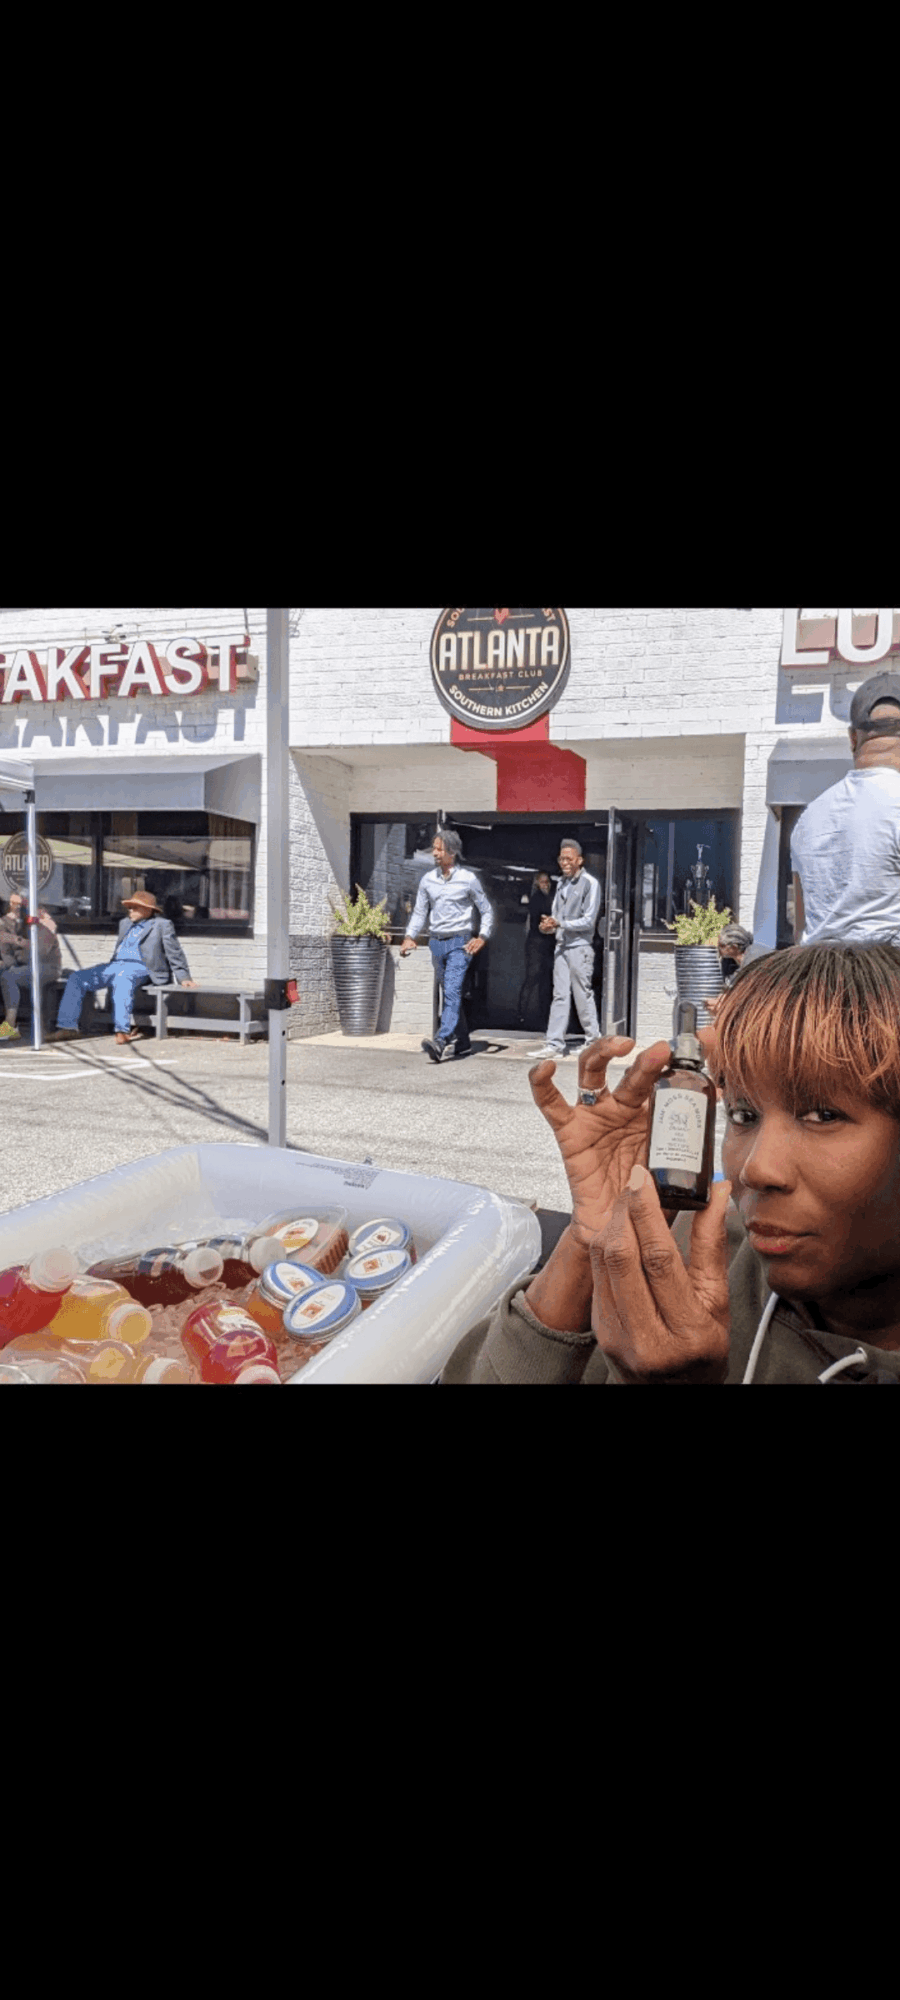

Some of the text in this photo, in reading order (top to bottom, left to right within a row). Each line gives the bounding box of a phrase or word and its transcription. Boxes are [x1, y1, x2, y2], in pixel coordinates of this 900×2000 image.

[439, 625, 560, 672] ATLANTA
[458, 669, 543, 681] BREAKFAST CLUB
[448, 681, 549, 717] SOUTHERN KITCHEN
[5, 854, 49, 871] ATLATA
